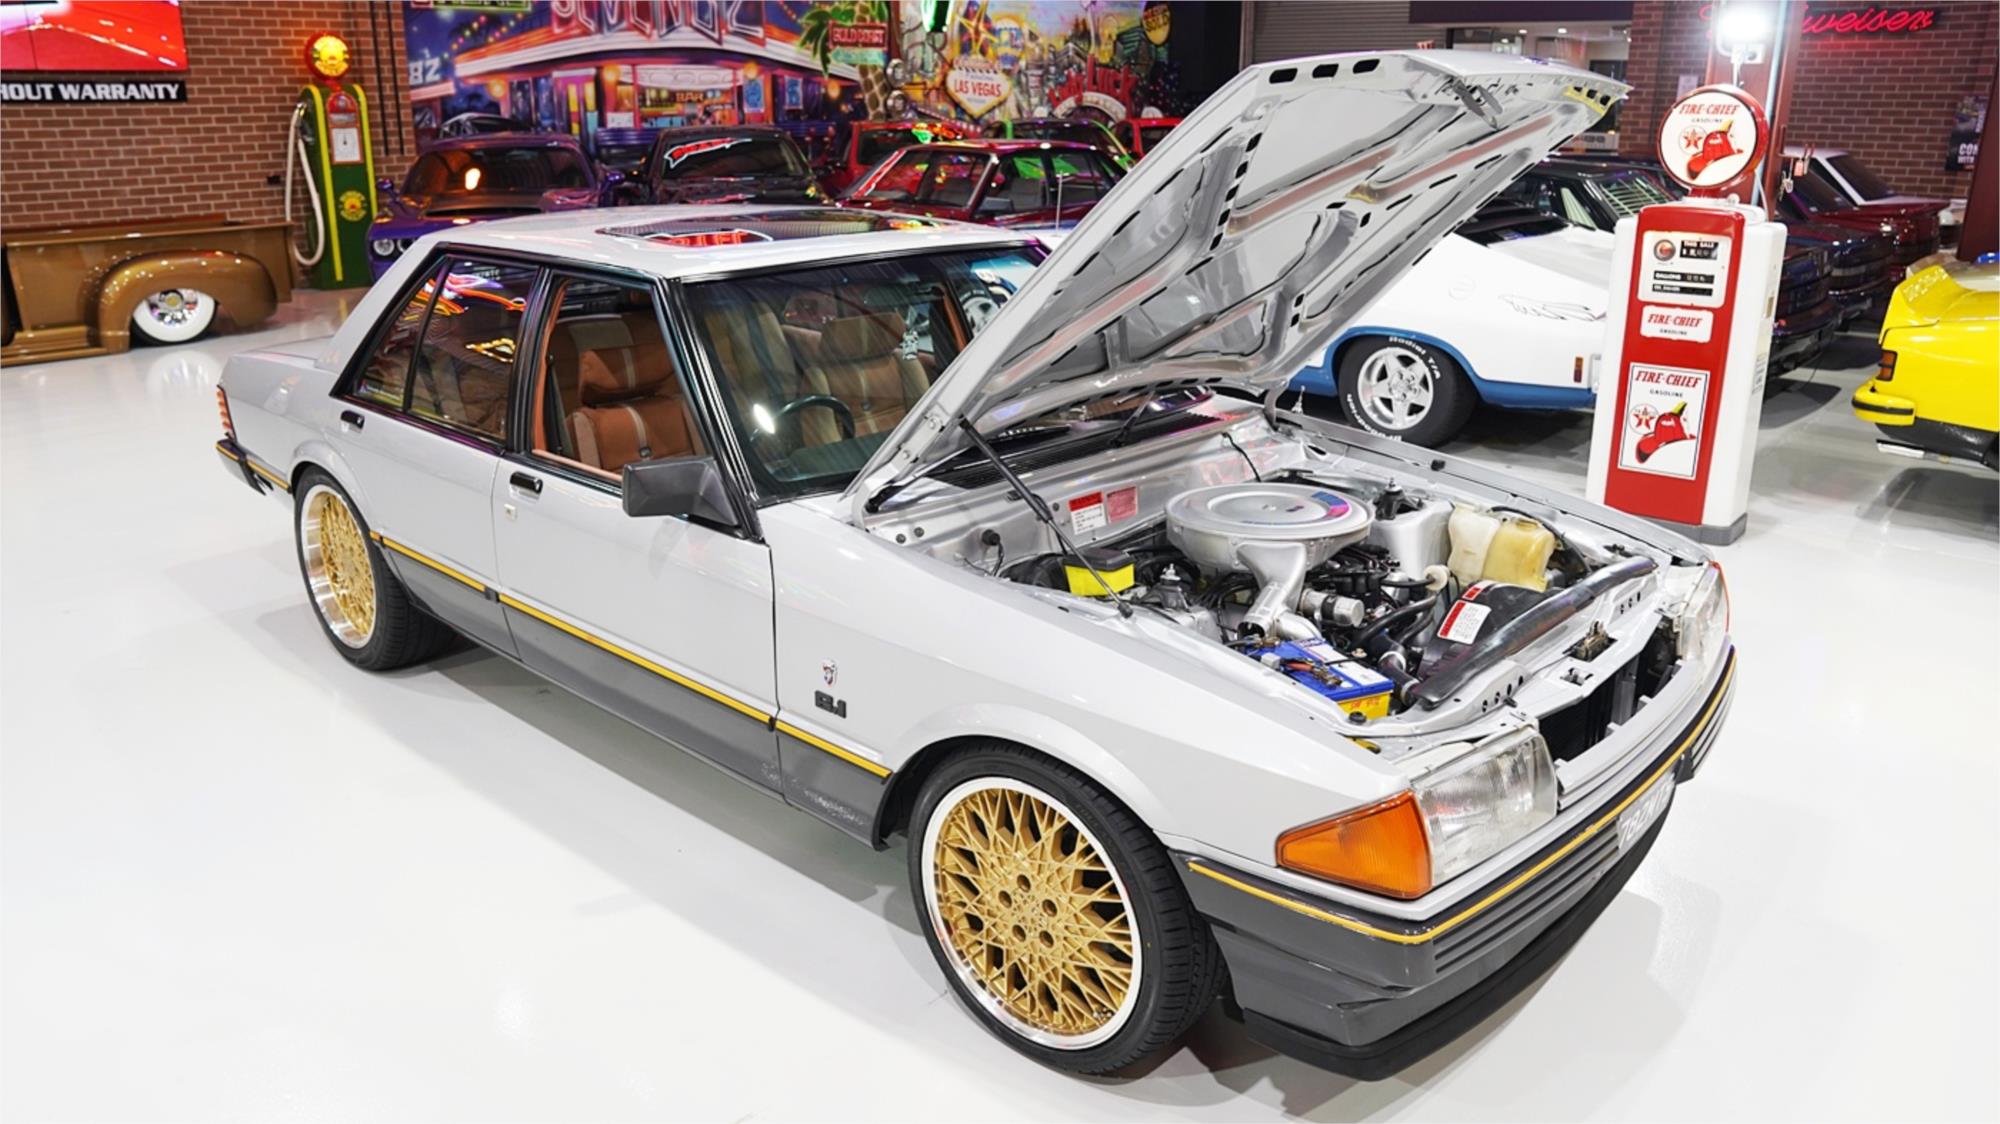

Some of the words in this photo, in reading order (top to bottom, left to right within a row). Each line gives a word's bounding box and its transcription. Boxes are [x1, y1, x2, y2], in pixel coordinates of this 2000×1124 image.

[1801, 6, 1934, 33] weiser
[57, 83, 179, 100] WARRANTY
[954, 79, 969, 94] LAS
[971, 81, 1002, 97] VEGAS
